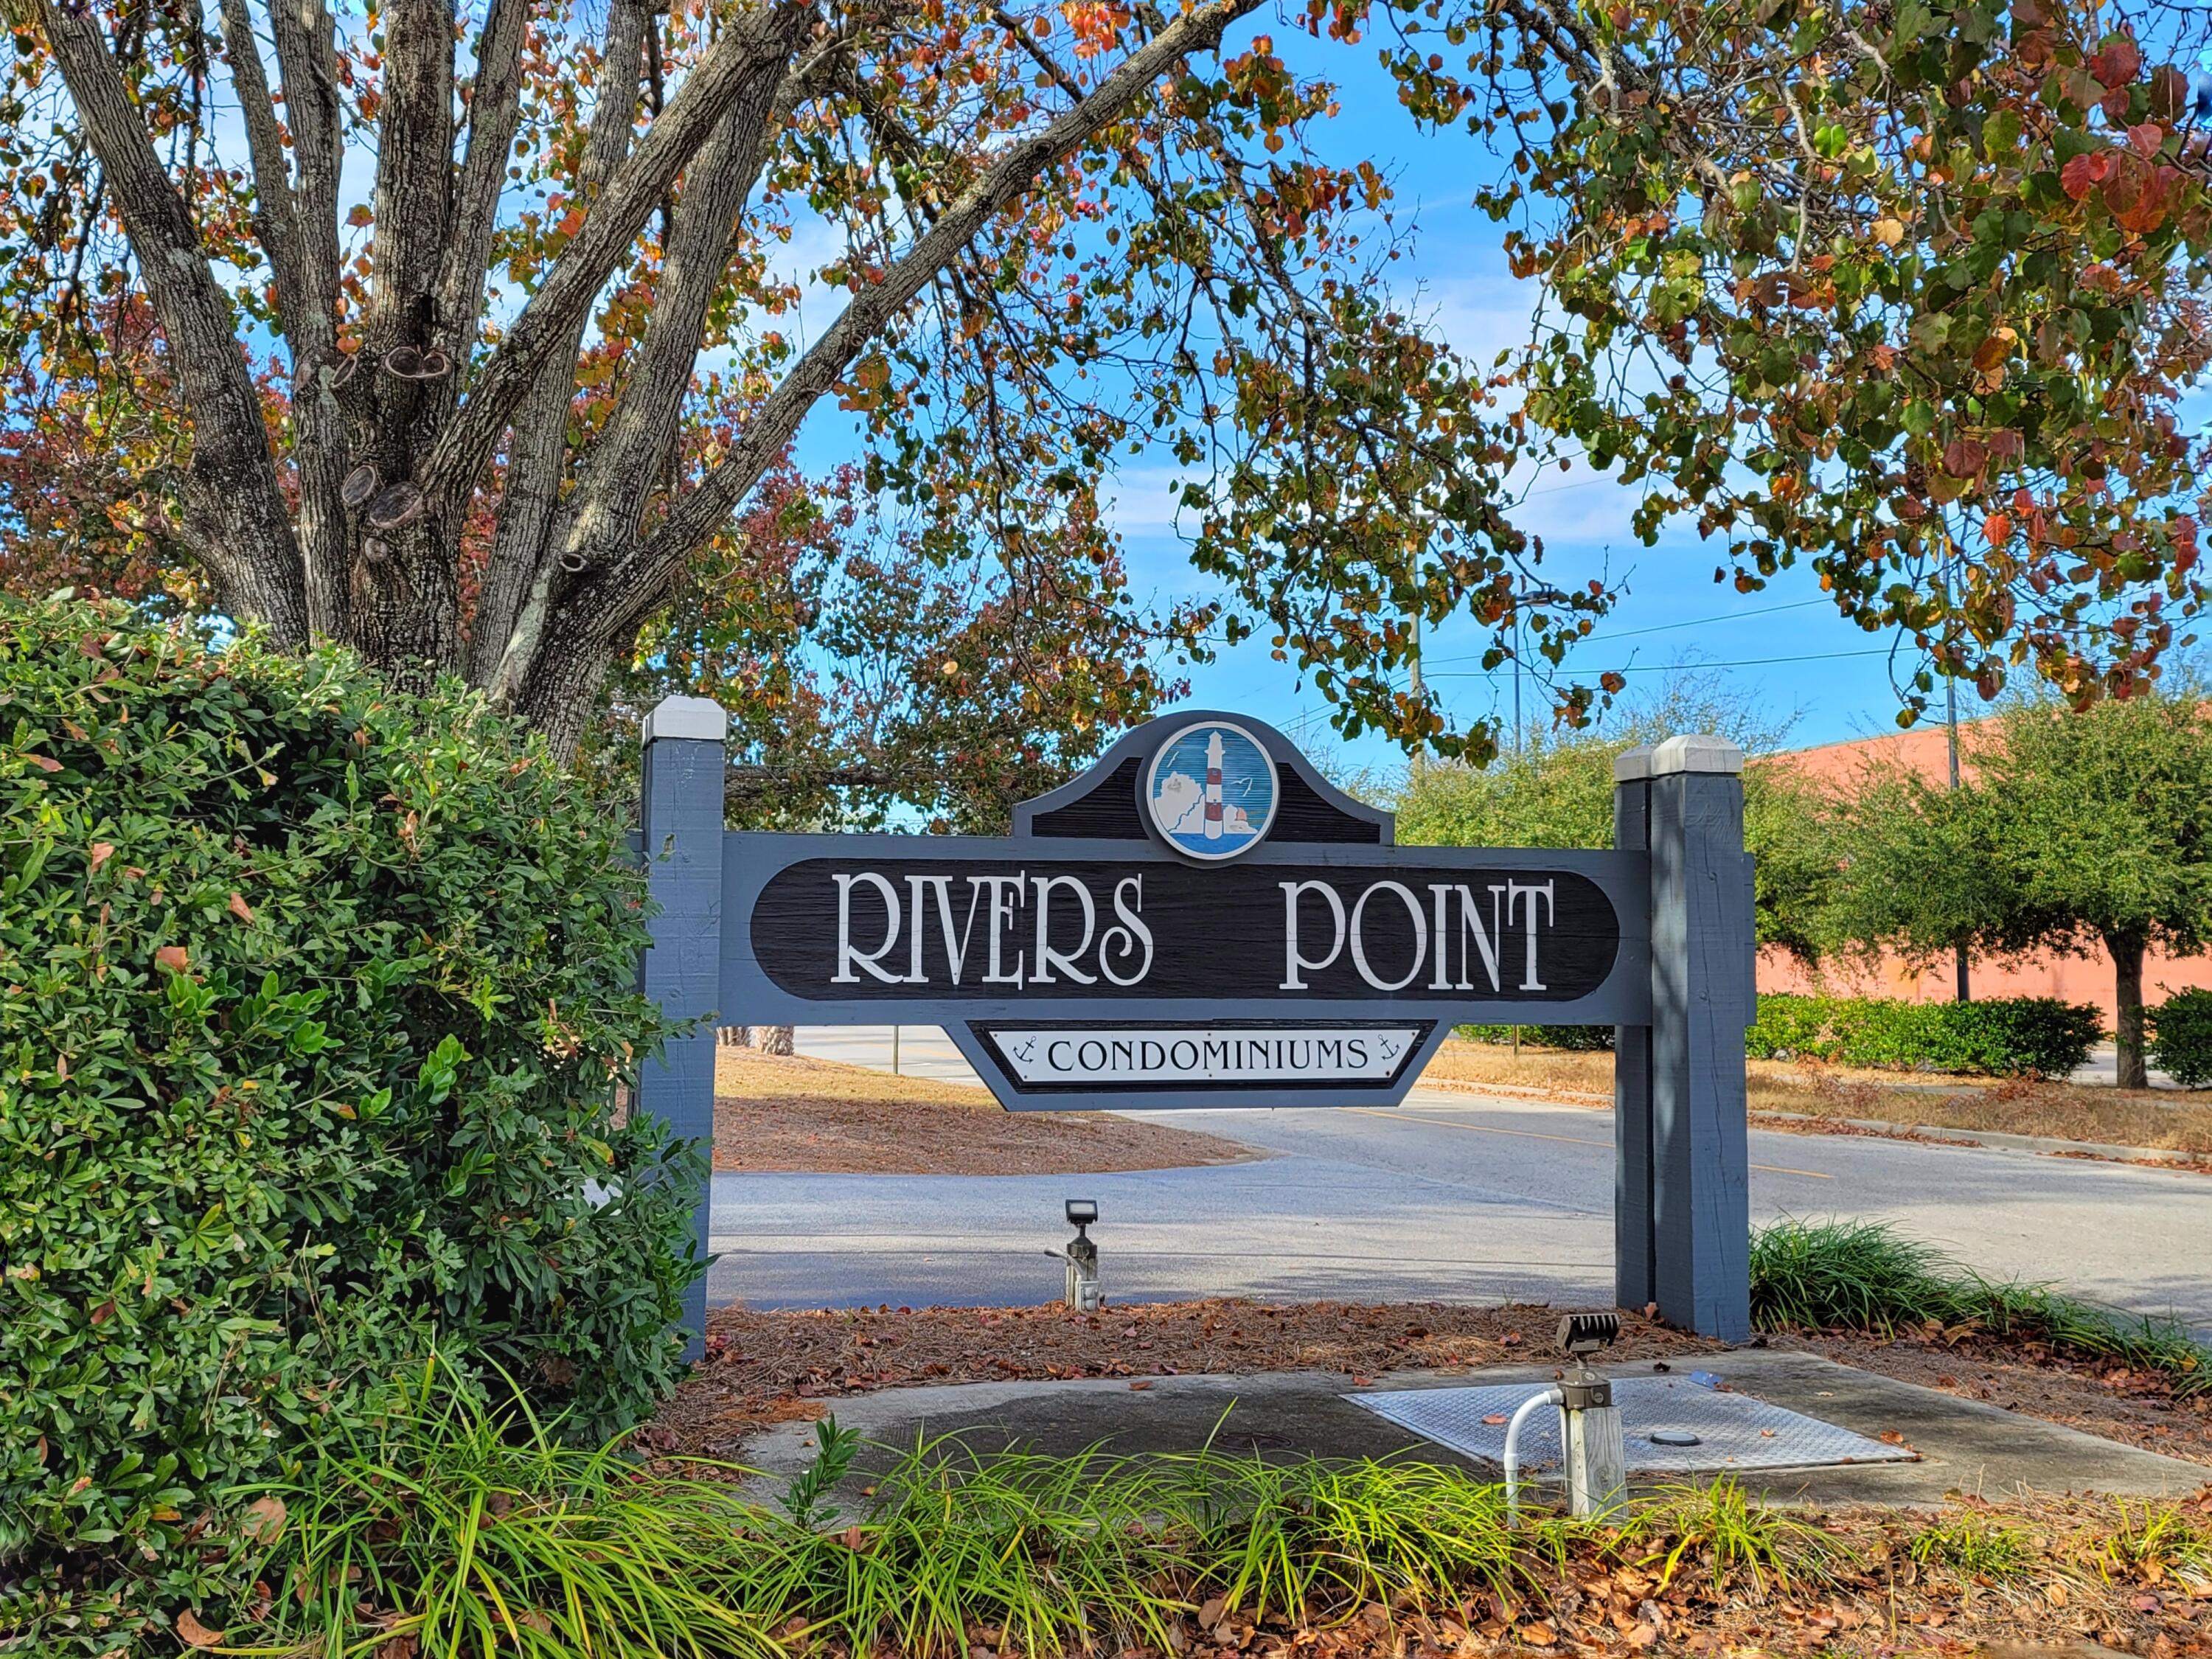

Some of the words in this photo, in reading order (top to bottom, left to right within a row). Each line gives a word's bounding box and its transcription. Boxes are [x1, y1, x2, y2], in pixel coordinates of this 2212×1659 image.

[831, 870, 1153, 990] RIVERS
[1279, 878, 1554, 992] POINT
[1048, 1039, 1368, 1071] CONDOMINIUMS
